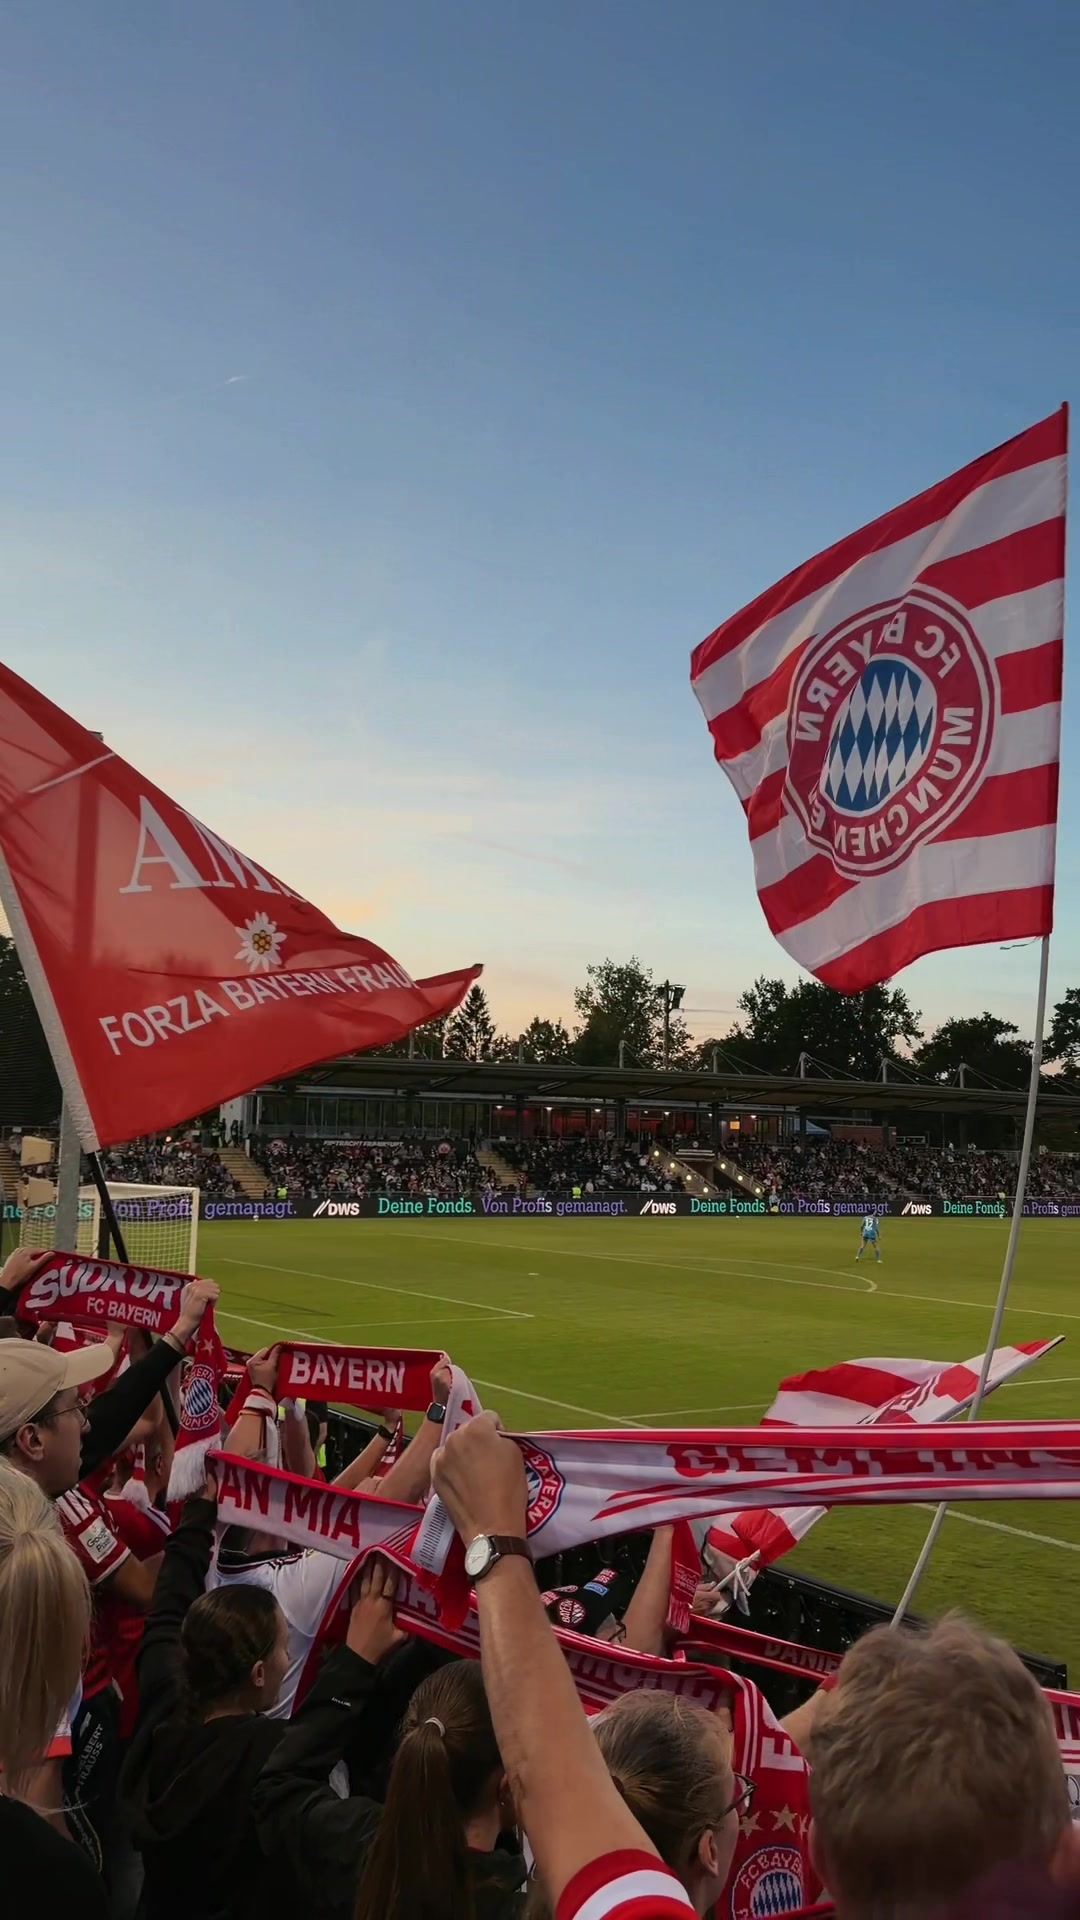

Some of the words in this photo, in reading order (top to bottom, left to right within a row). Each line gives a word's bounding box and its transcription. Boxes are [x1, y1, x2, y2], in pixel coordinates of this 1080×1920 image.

[99, 989, 230, 1056] FORZA
[219, 971, 347, 1011] BAYERN
[334, 962, 420, 993] FRAU
[146, 1199, 192, 1217] Profi
[204, 1201, 298, 1219] gemanagt.
[378, 1198, 424, 1214] Deine
[427, 1197, 477, 1214] Fonds.
[481, 1197, 509, 1214] Von
[512, 1197, 553, 1214] Profis
[556, 1199, 628, 1216] gemanagt.
[690, 1198, 727, 1213] Deine
[729, 1198, 769, 1213] Fonds.
[798, 1198, 831, 1213] Profis
[943, 1200, 973, 1214] Deine
[975, 1200, 1008, 1214] Fonds.
[1031, 1200, 1059, 1214] Profis
[25, 1259, 191, 1316] SÜDKUR
[87, 1296, 105, 1314] FC
[107, 1300, 162, 1328] BAYERN
[288, 1351, 406, 1394] BAYERN
[218, 1460, 273, 1516] AN
[284, 1480, 361, 1549] MIA
[527, 1454, 559, 1524] BAYERN
[740, 1864, 759, 1889] FC
